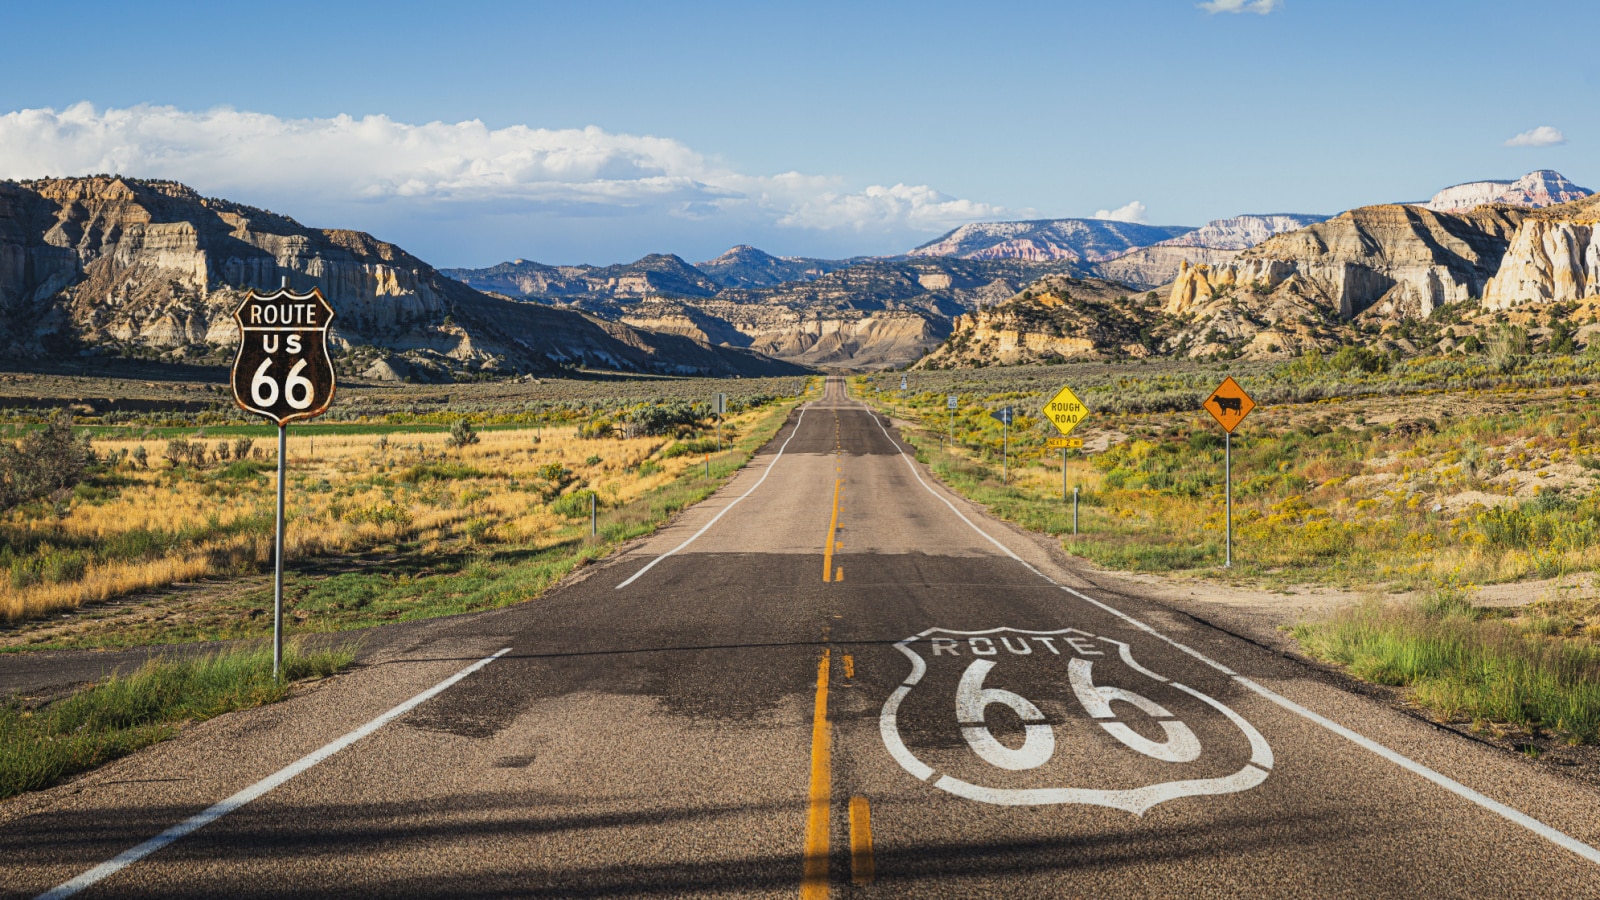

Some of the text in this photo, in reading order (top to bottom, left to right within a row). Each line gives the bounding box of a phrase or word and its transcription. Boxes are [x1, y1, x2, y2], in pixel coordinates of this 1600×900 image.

[250, 304, 317, 325] ROUTE
[262, 334, 303, 354] US
[251, 357, 315, 410] 66
[1051, 402, 1080, 412] ROUGH
[1055, 414, 1078, 423] ROAD
[1067, 438, 1071, 447] 2
[931, 636, 1105, 657] ROUTE
[955, 657, 1202, 771] 66
